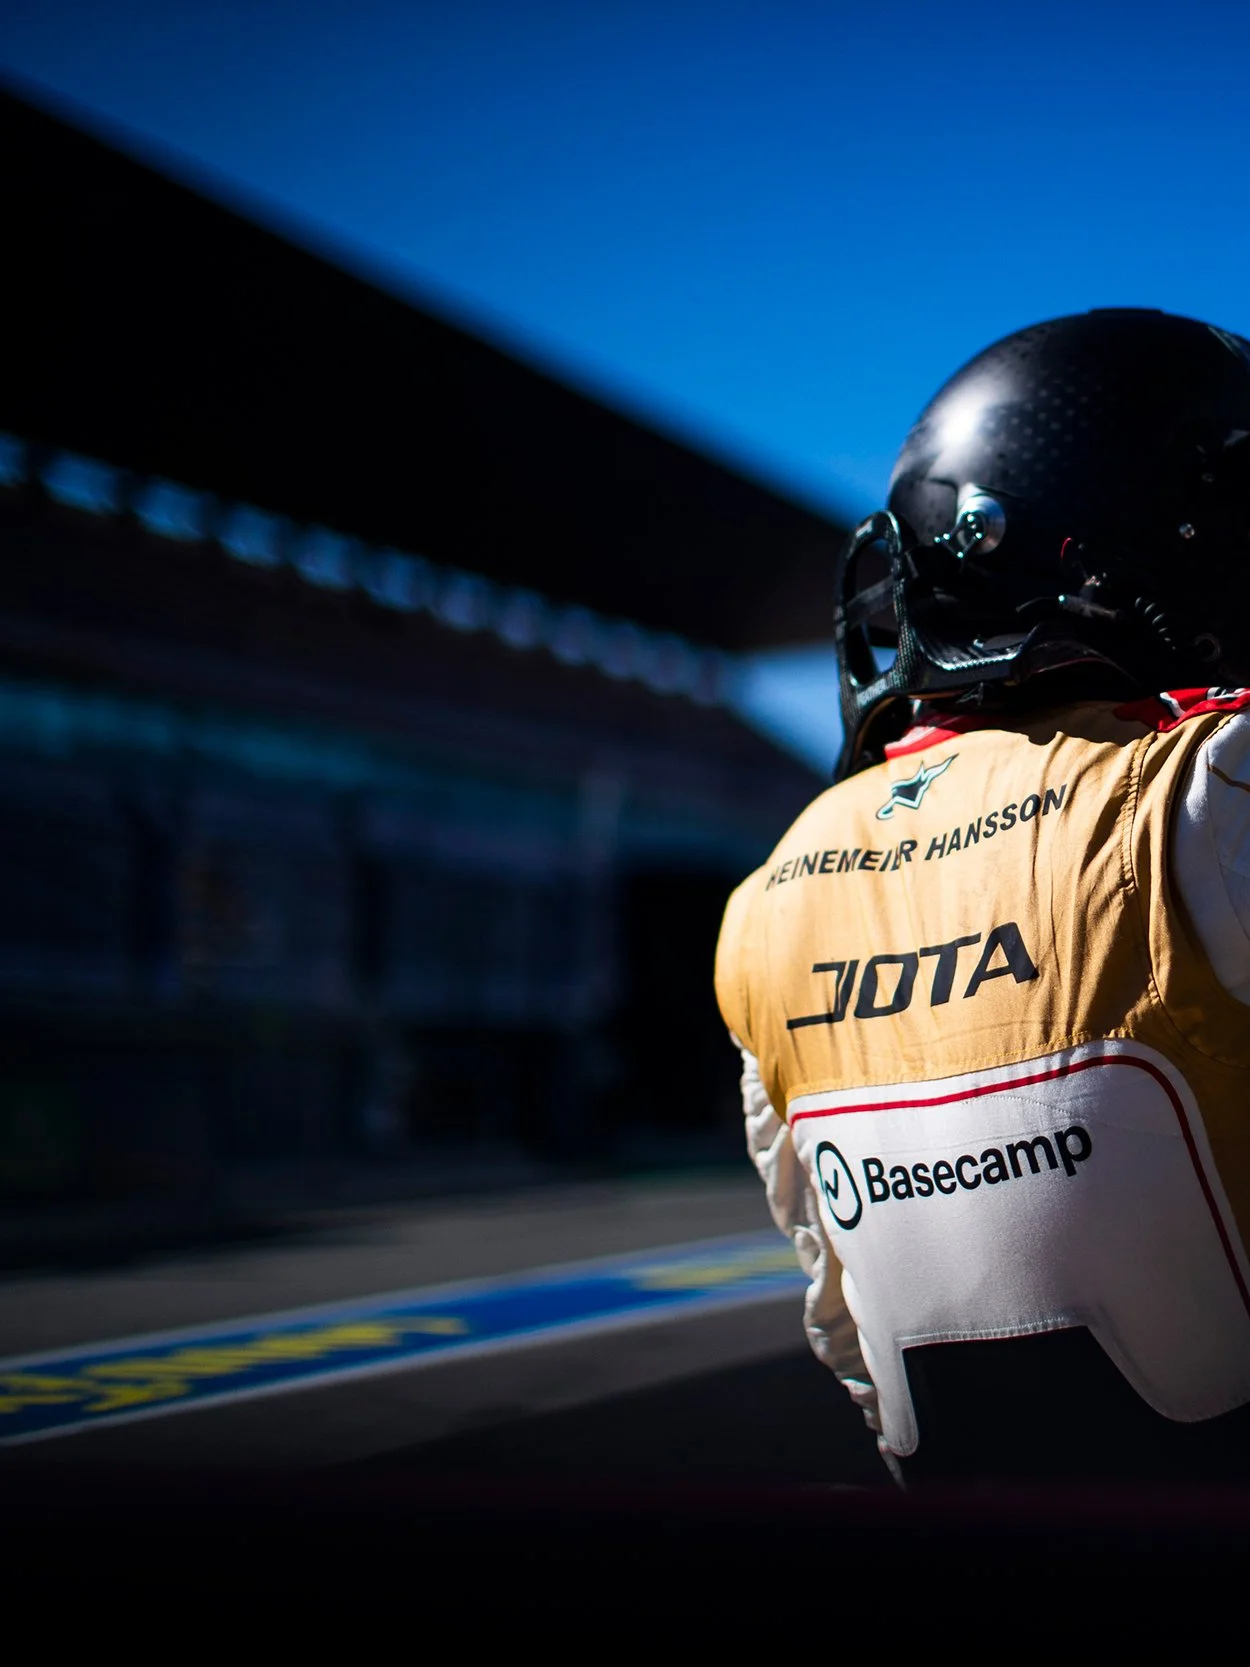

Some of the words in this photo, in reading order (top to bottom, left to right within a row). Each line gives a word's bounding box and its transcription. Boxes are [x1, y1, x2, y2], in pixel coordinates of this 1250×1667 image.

[924, 783, 1067, 861] HANSSON
[786, 921, 1040, 1030] JOTA
[861, 1125, 1092, 1204] Basecamp
